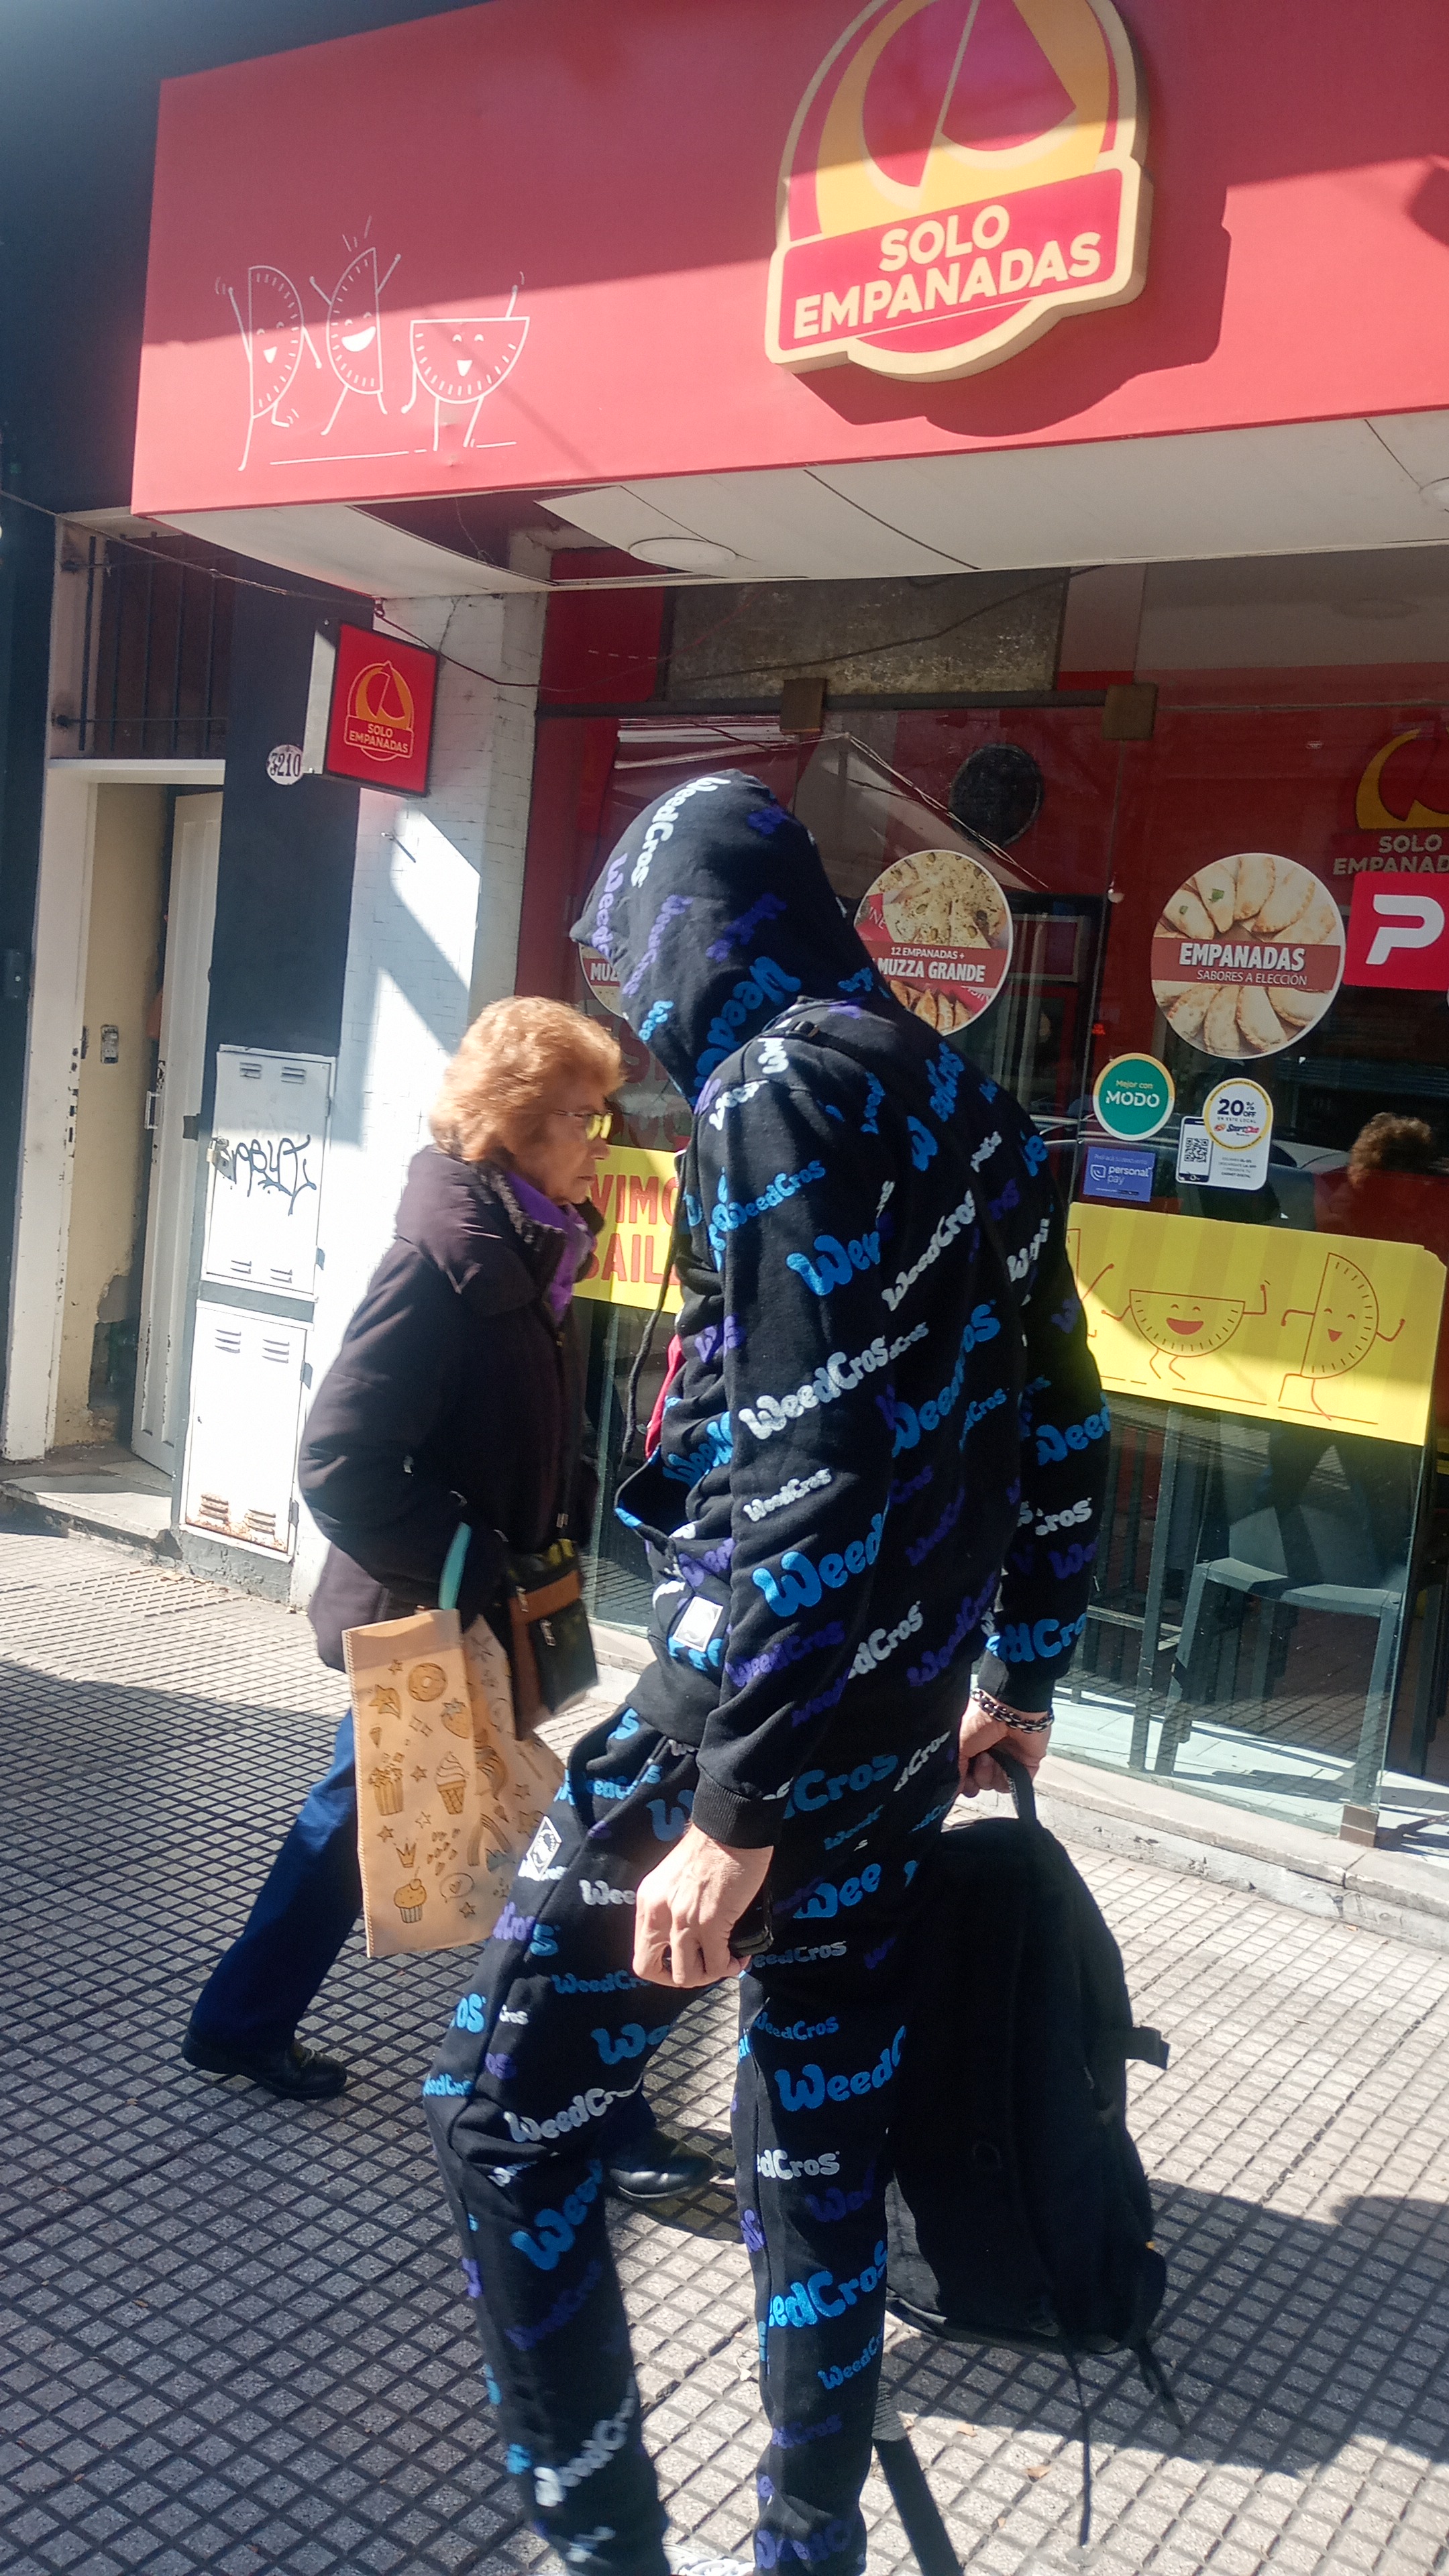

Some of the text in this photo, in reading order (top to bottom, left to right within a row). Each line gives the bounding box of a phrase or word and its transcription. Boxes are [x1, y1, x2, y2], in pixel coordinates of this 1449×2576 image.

[878, 205, 1010, 273] SOLO
[794, 231, 1101, 339] EMPANADAS
[367, 722, 394, 739] SOLO
[349, 731, 409, 754] EMPANADAS
[1379, 834, 1443, 853] SOLO
[891, 947, 902, 956] 12
[902, 948, 958, 960] EMPANADAS
[1179, 943, 1305, 972] EMPANADAS
[877, 958, 986, 983] MUZZA GRANDE
[1197, 970, 1244, 982] SABORES
[1245, 975, 1253, 983] A
[1116, 1079, 1138, 1089] Mejor
[1106, 1090, 1161, 1108] MODO
[1217, 1098, 1244, 1116] 20
[1243, 1110, 1256, 1118] OFF
[1108, 1165, 1148, 1178] personal
[1108, 1174, 1126, 1186] pay
[739, 1334, 891, 1440] WeedCros
[746, 1941, 847, 1972] eedCros
